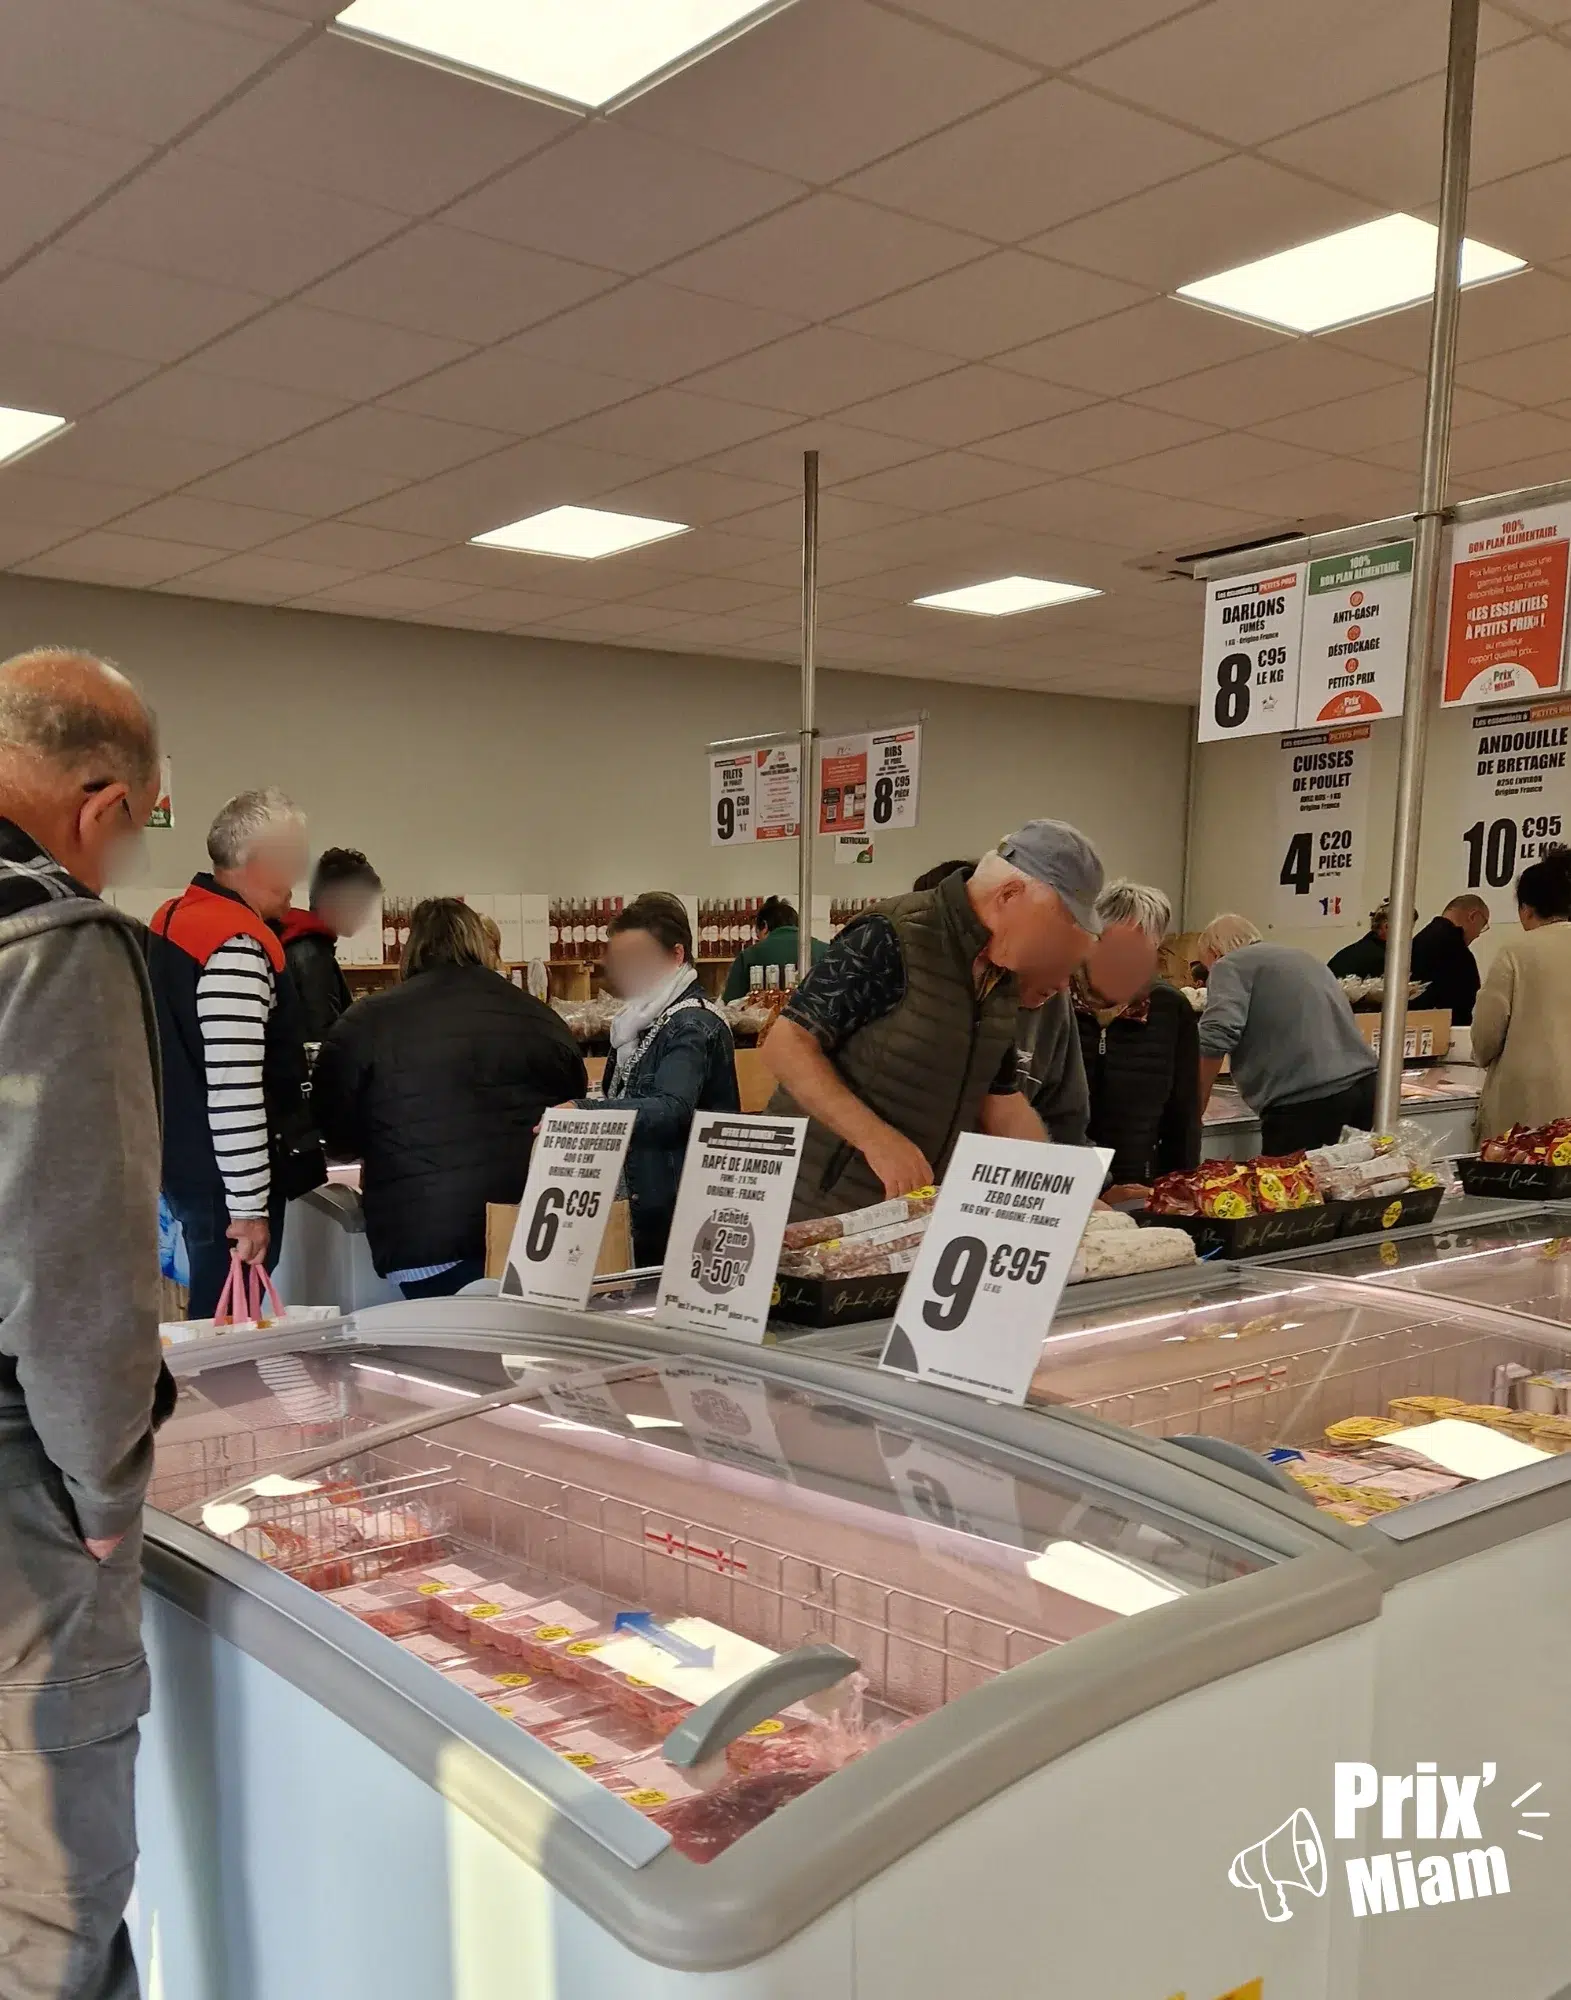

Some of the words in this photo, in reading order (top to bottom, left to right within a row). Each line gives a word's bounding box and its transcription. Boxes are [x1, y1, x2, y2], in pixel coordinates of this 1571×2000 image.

[1502, 518, 1525, 534] 100%
[1468, 540, 1484, 554] BON
[1485, 536, 1506, 550] PLAN
[1506, 525, 1558, 546] ALIMENTAIRE
[1335, 570, 1354, 584] PLAN
[1354, 560, 1400, 580] ALIMENTAIRE
[1503, 572, 1513, 582] de
[1223, 596, 1285, 624] DARLONS
[1333, 604, 1380, 624] ANTI-GASPI
[1490, 594, 1549, 619] ESSENTIELS
[1239, 619, 1265, 634] FUMÉS
[1465, 623, 1473, 640] À
[1474, 620, 1508, 639] PETITS
[1328, 637, 1380, 658] DÉSTOCKAGE
[1215, 653, 1252, 728] 8
[1258, 646, 1286, 667] €95
[1257, 671, 1267, 685] LE
[1269, 668, 1284, 683] KG
[1328, 674, 1355, 690] PETITS
[1356, 671, 1376, 685] PRIX
[1478, 727, 1569, 755] ANDOUILLE
[1293, 750, 1354, 773] CUISSES
[1477, 760, 1494, 776] DE
[1497, 752, 1566, 774] BRETAGNE
[723, 768, 743, 780] FILETS
[1293, 777, 1307, 792] DE
[1310, 772, 1352, 790] POULET
[873, 777, 893, 824] 8
[895, 775, 910, 787] €95
[1495, 786, 1519, 797] Origine
[1520, 785, 1543, 793] France
[717, 797, 734, 840] 9
[1319, 852, 1352, 870] PIÈCE
[1463, 818, 1517, 888] 10
[1522, 816, 1561, 838] €95
[1521, 843, 1535, 858] LE
[1280, 832, 1314, 895] 4
[1320, 830, 1352, 851] €20
[547, 1120, 589, 1134] TRANCHES
[590, 1122, 600, 1134] DE
[544, 1136, 554, 1148] DE
[555, 1137, 578, 1150] PORC
[578, 1135, 622, 1151] SUPÉRIEUR
[549, 1166, 575, 1177] ORIGINE
[579, 1168, 601, 1179] FRANCE
[701, 1153, 728, 1171] RAPÉ
[728, 1157, 741, 1172] DE
[742, 1158, 783, 1176] JAMBON
[972, 1163, 1012, 1186] FILET
[1011, 1169, 1075, 1195] MIGNON
[706, 1185, 735, 1198] ORIGINE
[739, 1188, 766, 1201] FRANCE
[984, 1190, 1012, 1206] ZERO
[1012, 1194, 1045, 1210] GASPI
[526, 1187, 565, 1262] 6
[566, 1190, 601, 1218] €95
[712, 1209, 717, 1222] 1
[718, 1211, 749, 1225] acheté
[975, 1205, 991, 1216] ENV
[995, 1208, 1027, 1222] ORIGINE
[1029, 1214, 1060, 1228] FRANCE
[691, 1253, 702, 1279] à
[704, 1259, 748, 1287] -50%
[922, 1235, 987, 1331] 9
[990, 1244, 1051, 1285] €95
